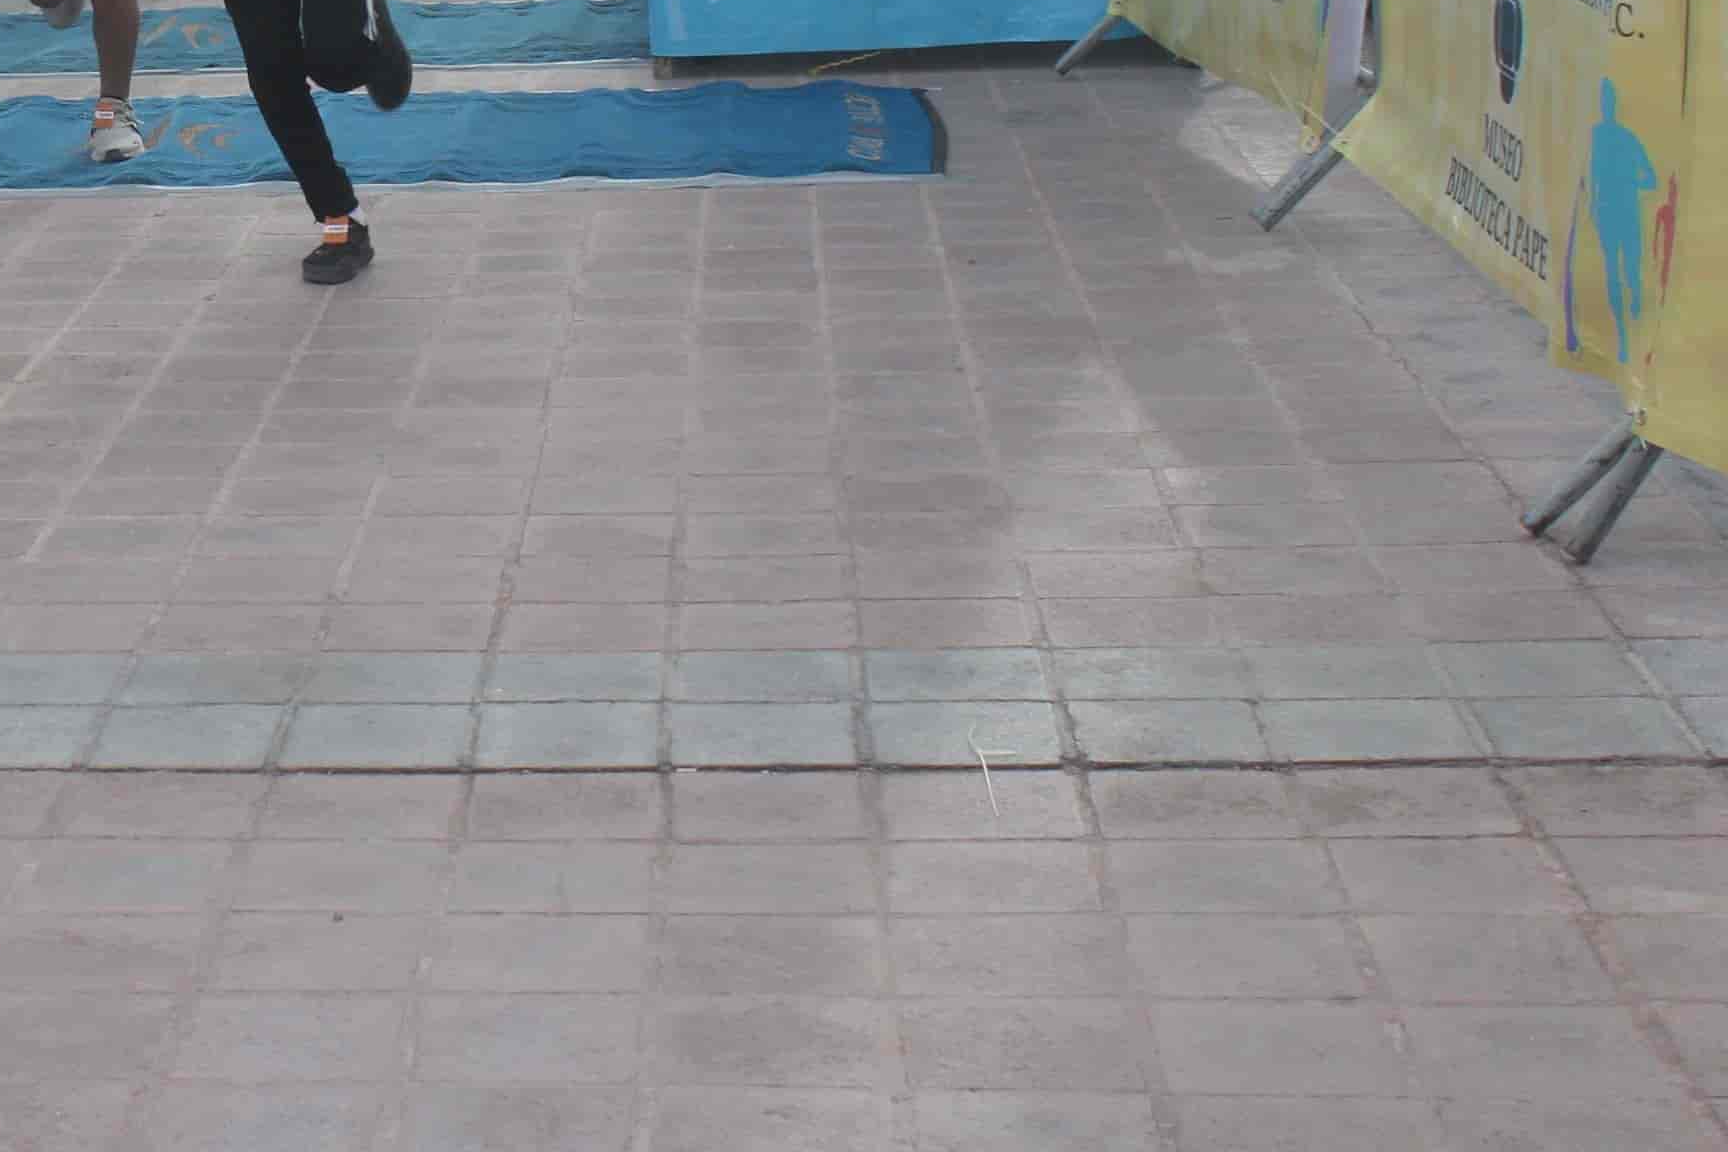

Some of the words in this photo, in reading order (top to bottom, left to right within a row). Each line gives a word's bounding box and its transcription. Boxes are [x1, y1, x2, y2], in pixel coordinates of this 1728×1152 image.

[1483, 112, 1523, 183] MUSEO
[1445, 155, 1512, 251] BIBLIOTECA
[1512, 214, 1549, 281] PAPE
